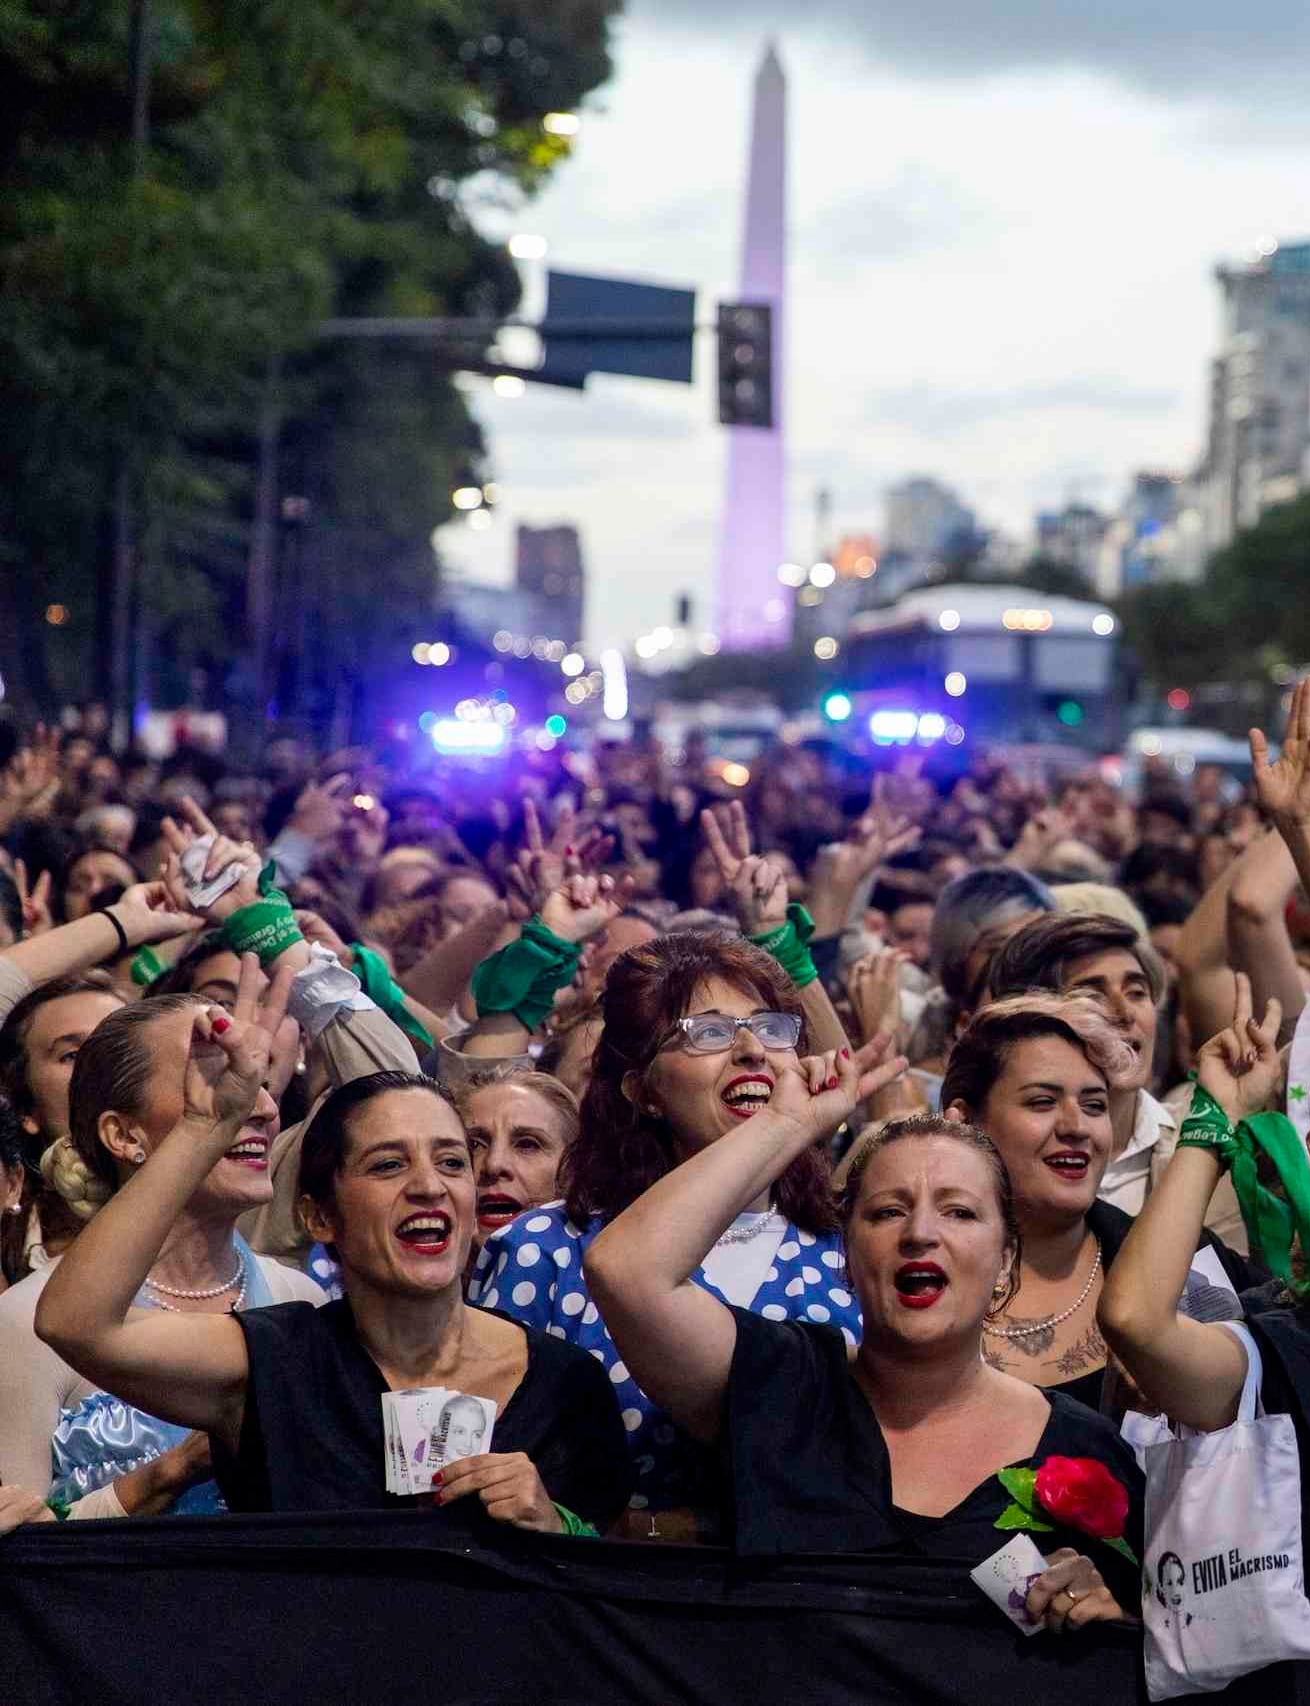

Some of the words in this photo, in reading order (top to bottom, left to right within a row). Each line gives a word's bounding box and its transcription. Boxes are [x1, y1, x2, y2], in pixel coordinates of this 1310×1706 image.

[1192, 1554, 1227, 1594] EVITA
[1228, 1548, 1242, 1565] EL
[1229, 1554, 1290, 1581] MACRISMO
